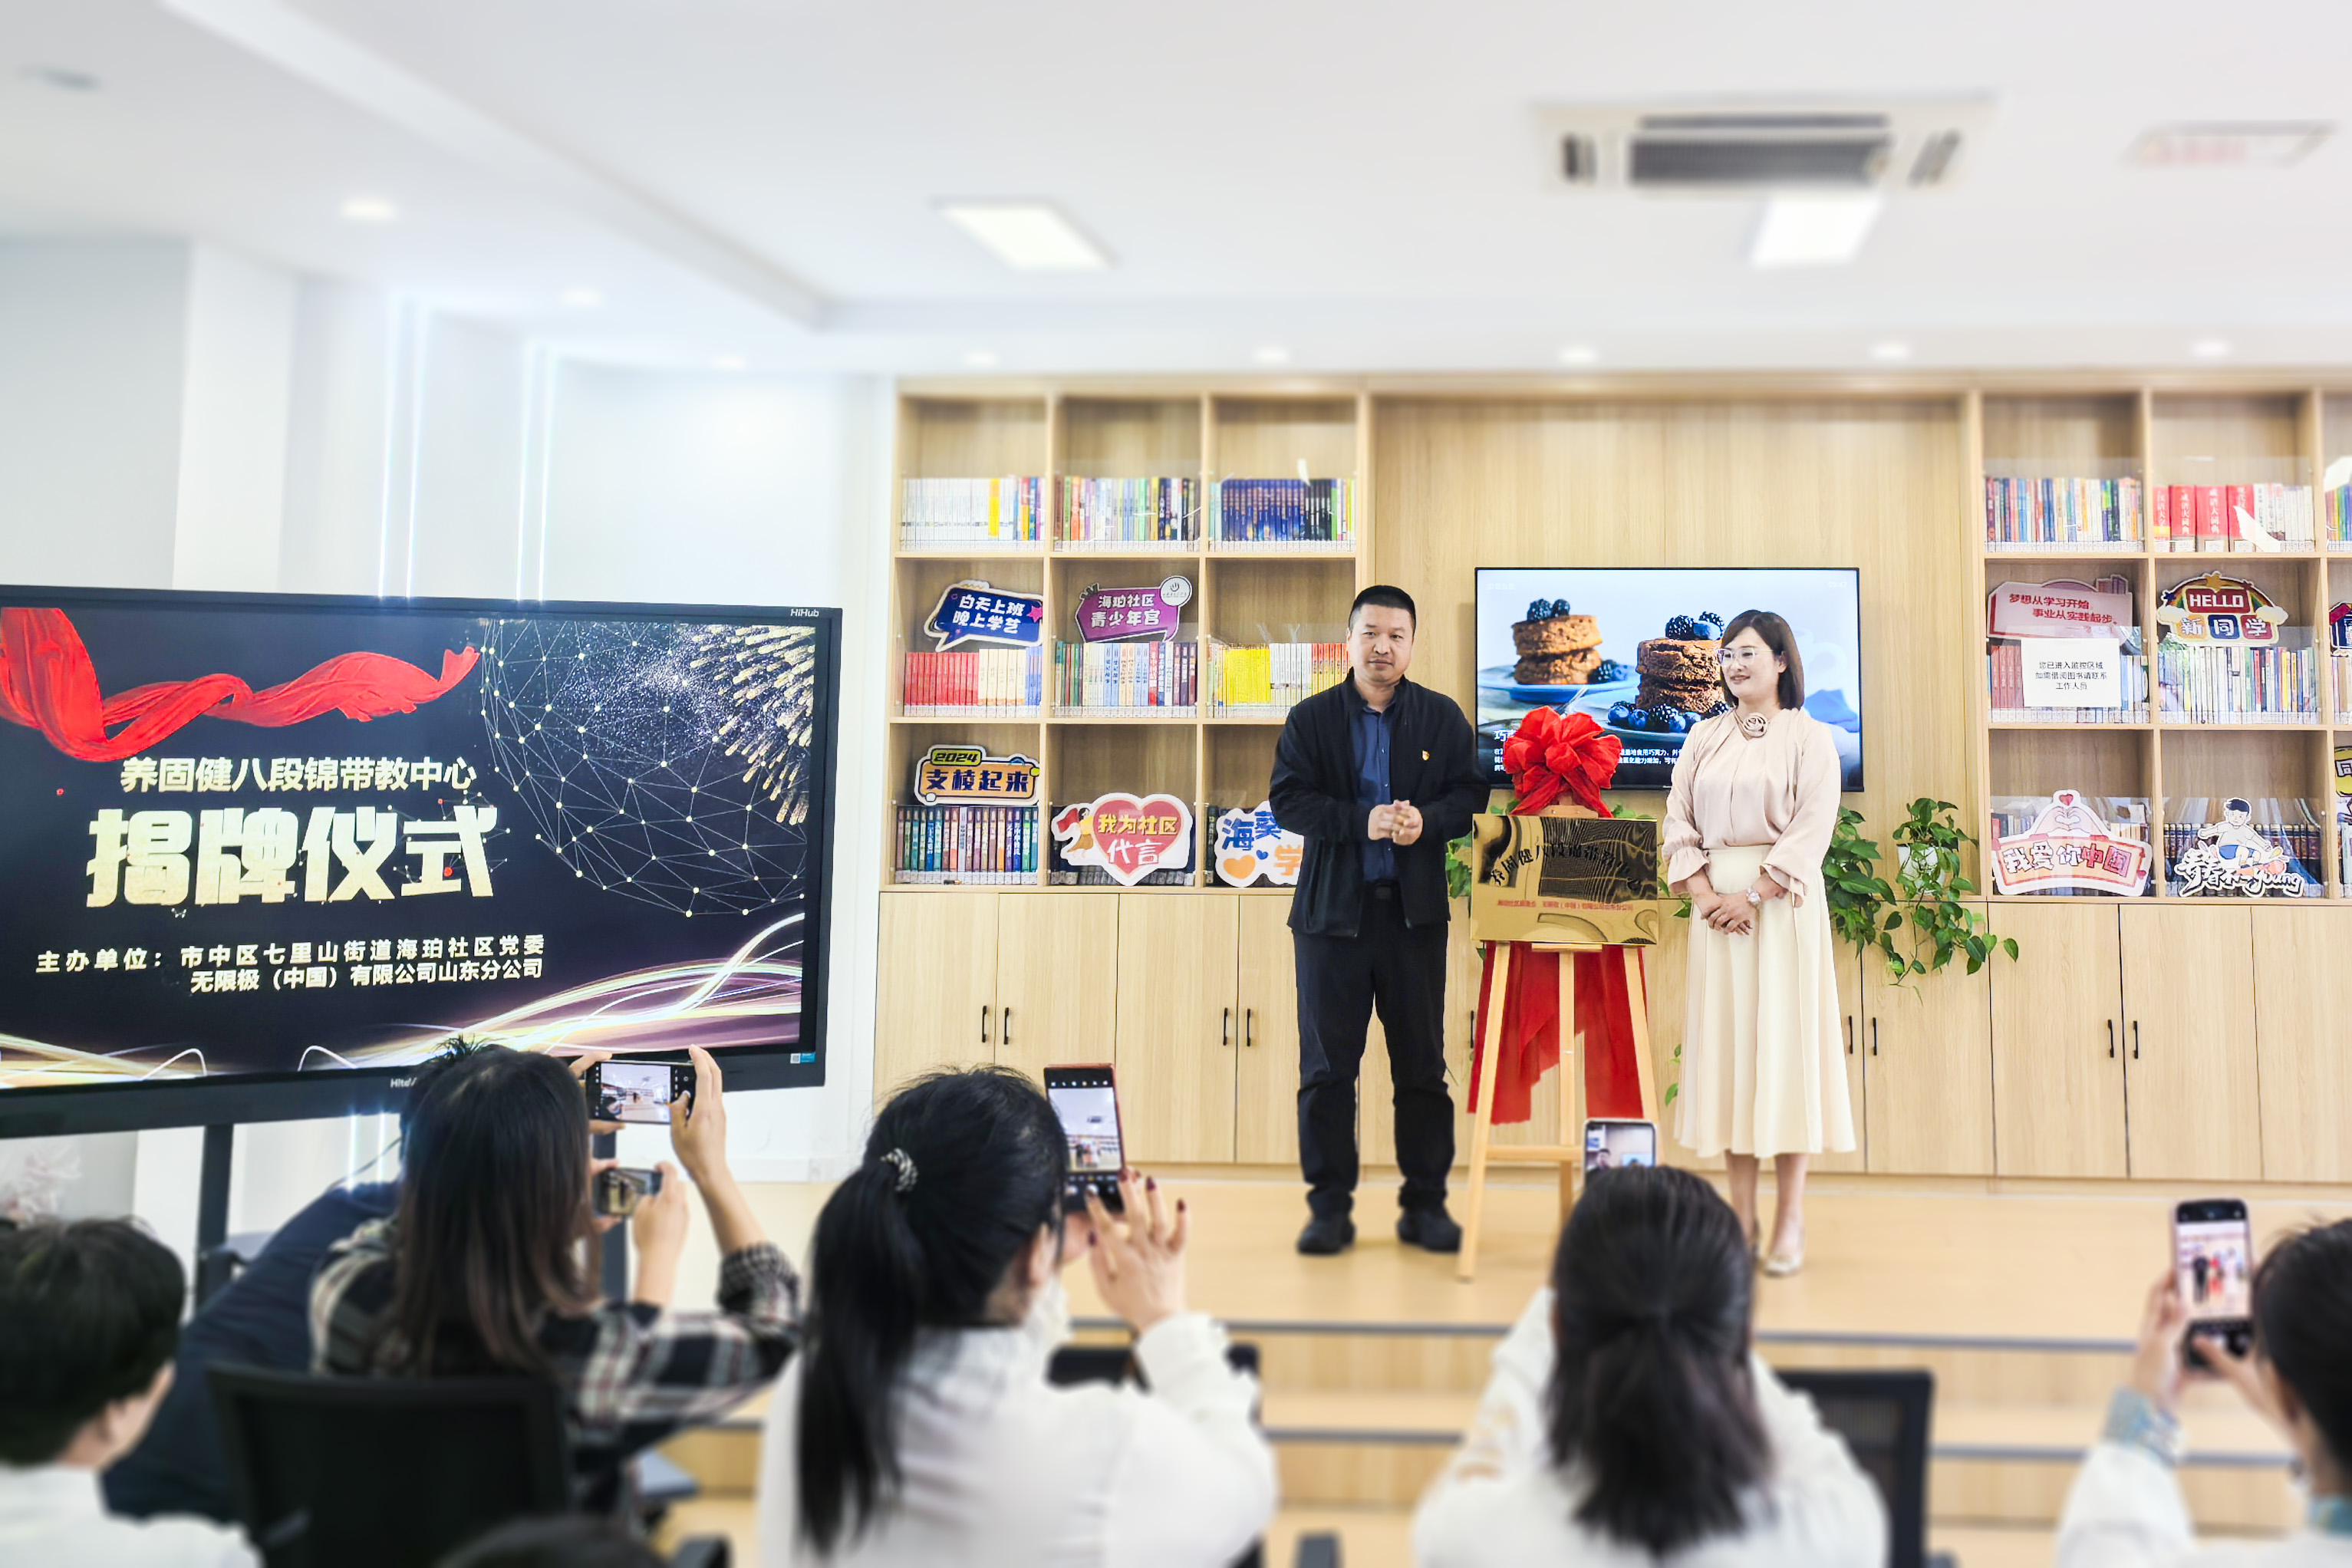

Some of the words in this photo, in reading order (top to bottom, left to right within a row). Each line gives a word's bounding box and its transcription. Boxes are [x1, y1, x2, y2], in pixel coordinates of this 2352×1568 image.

[790, 608, 819, 617] HiHub
[959, 594, 1026, 617] 白天上班
[1098, 593, 1156, 609] 海珀社区
[2189, 594, 2245, 608] HELLO
[952, 610, 1021, 634] 晚上学艺
[1091, 609, 1161, 628] 青少年宫
[2180, 618, 2268, 637] 新同学
[2055, 681, 2087, 690] 工作人员
[934, 753, 979, 763] 2024
[120, 756, 476, 792] 养固健八段锦带教中心
[926, 769, 1029, 792] 支棱起来
[1098, 813, 1178, 835] 我为社区
[86, 805, 498, 908] 揭牌仪式
[1106, 838, 1163, 866] 代言
[2002, 840, 2133, 878] 我爱你中国
[180, 934, 545, 969] 市中区七里山街道海珀社区党委
[190, 958, 543, 993] 无限极（中国）有限公司山东分公司
